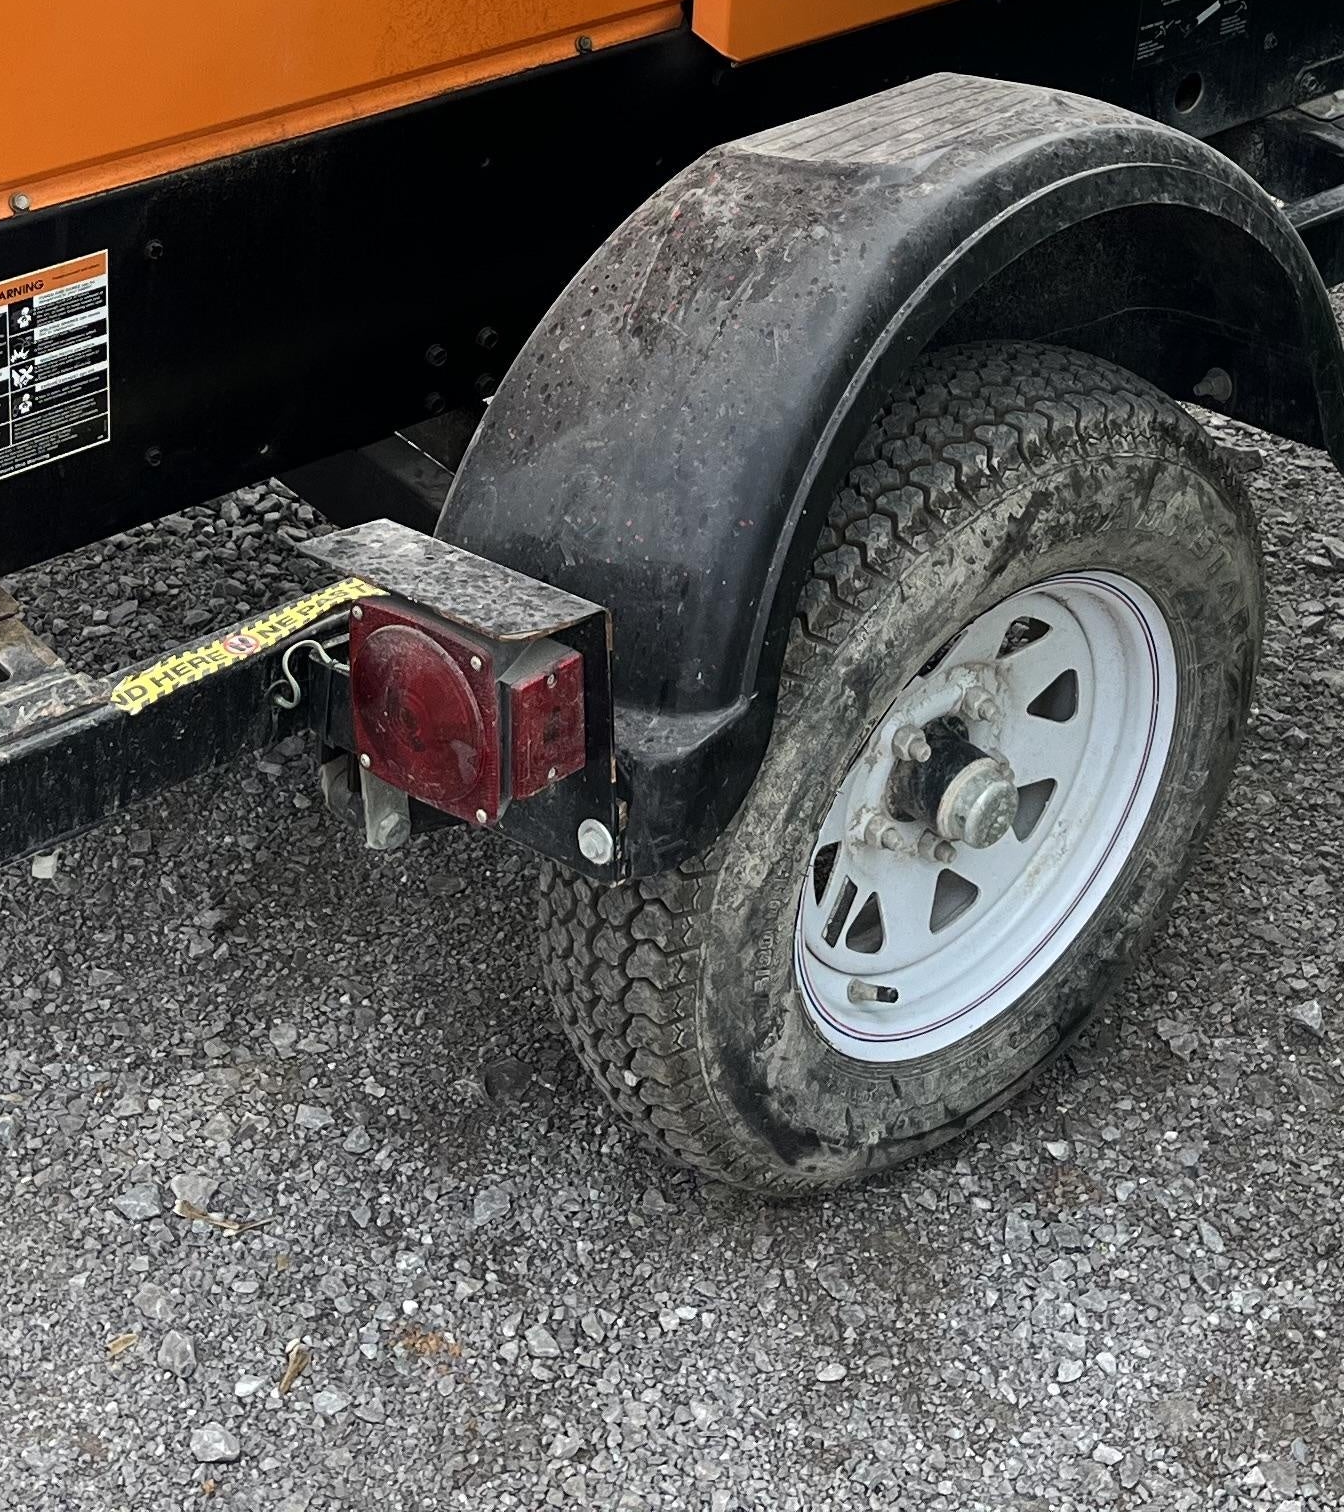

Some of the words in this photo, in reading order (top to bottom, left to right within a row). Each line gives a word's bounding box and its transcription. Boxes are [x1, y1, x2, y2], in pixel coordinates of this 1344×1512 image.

[150, 650, 229, 689] HERE
[256, 616, 297, 640] NE
[297, 589, 348, 617] PAS
